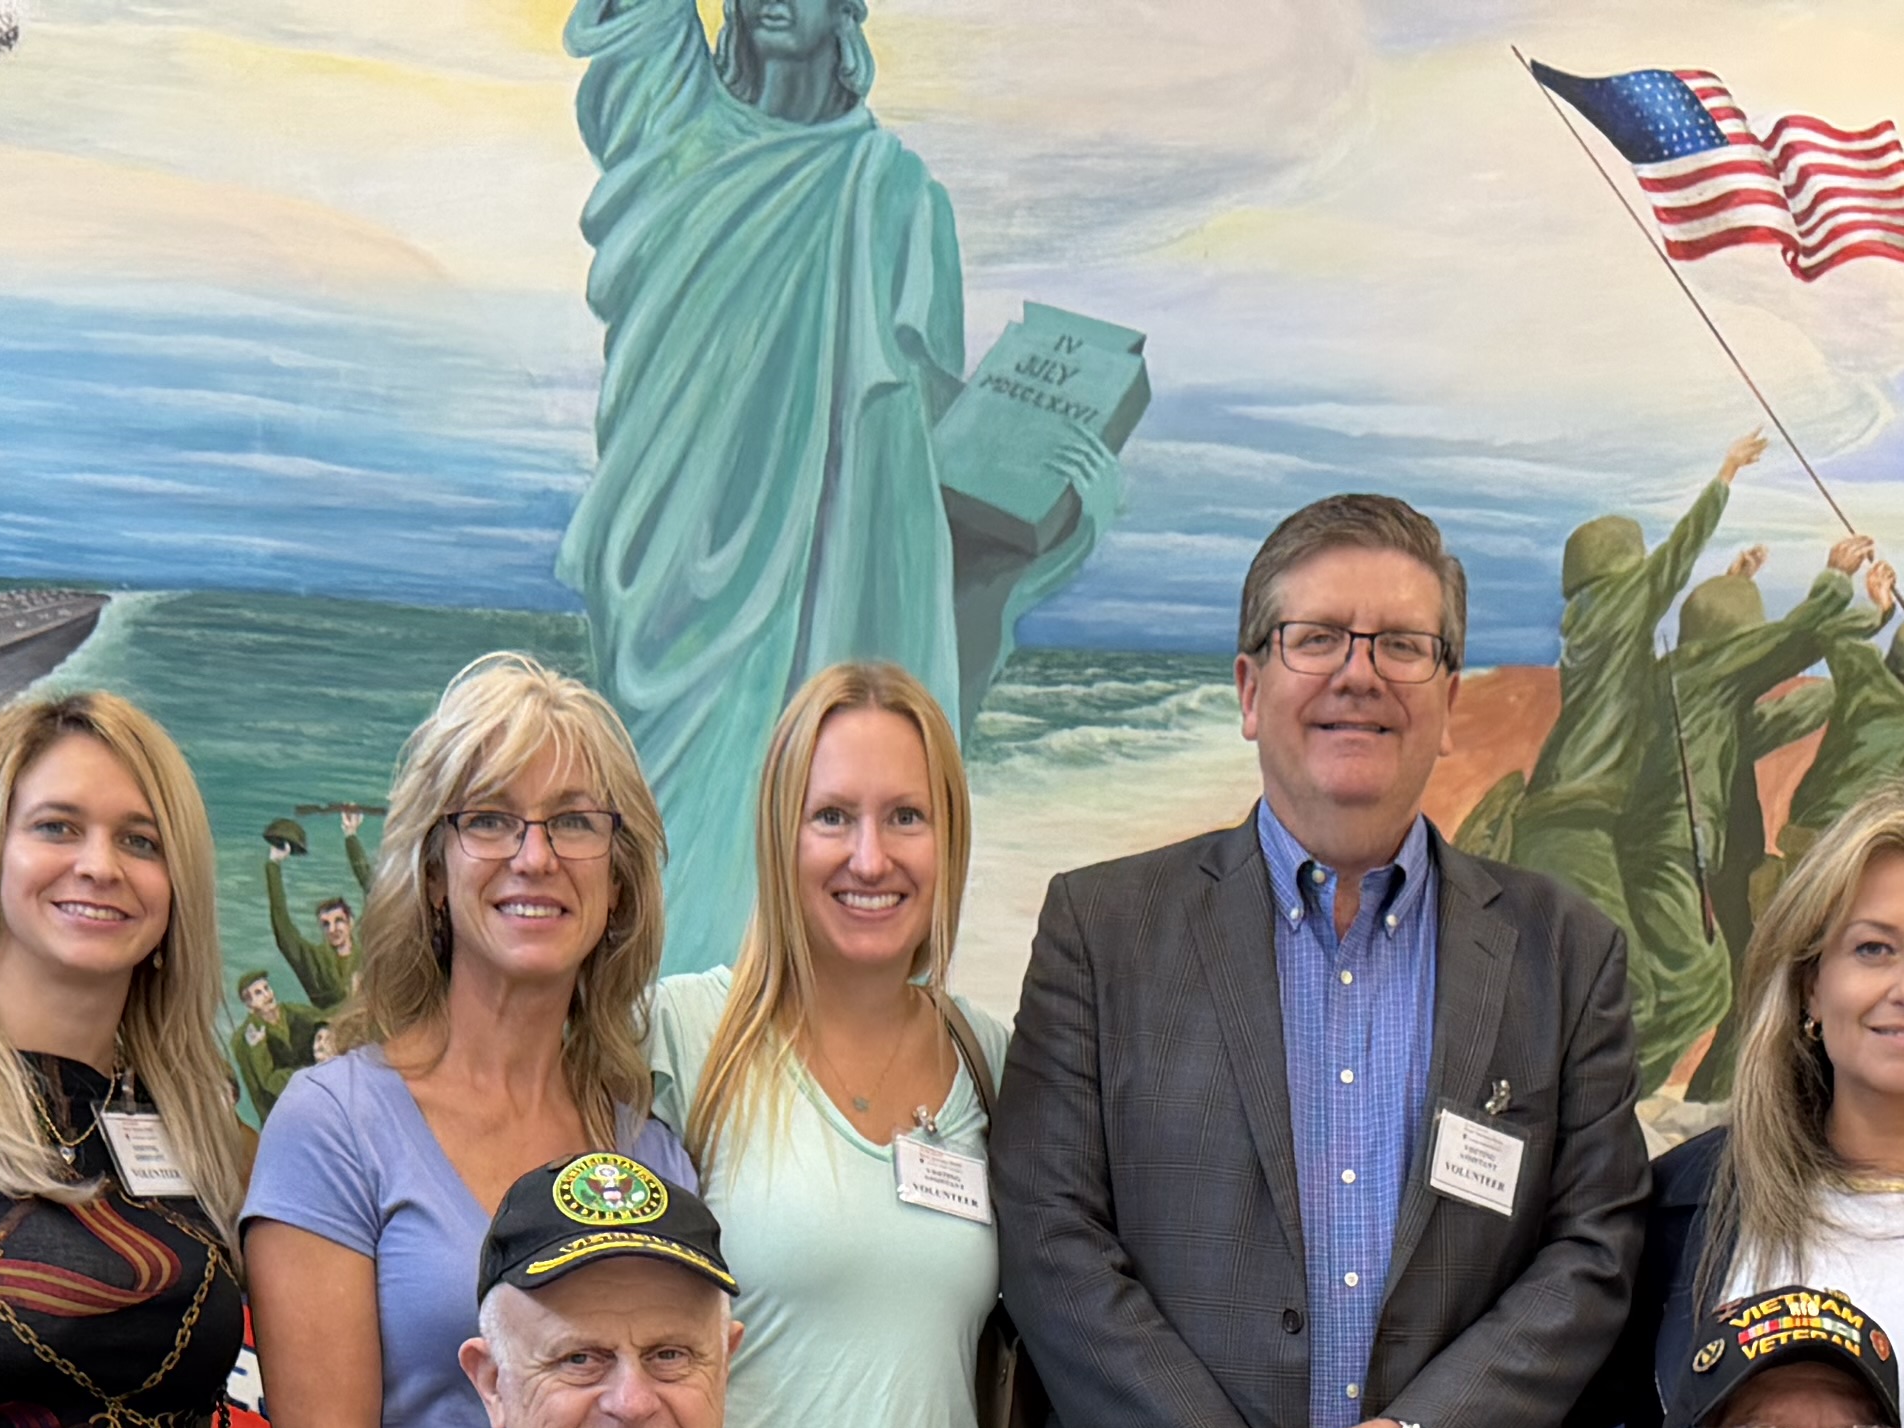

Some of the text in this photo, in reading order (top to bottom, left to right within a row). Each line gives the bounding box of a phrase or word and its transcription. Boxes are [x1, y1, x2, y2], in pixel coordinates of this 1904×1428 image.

[1053, 335, 1084, 354] IV
[1015, 356, 1080, 386] JULY
[1445, 1161, 1506, 1192] VOLUNTEER
[1729, 1292, 1864, 1330] VIETNAM
